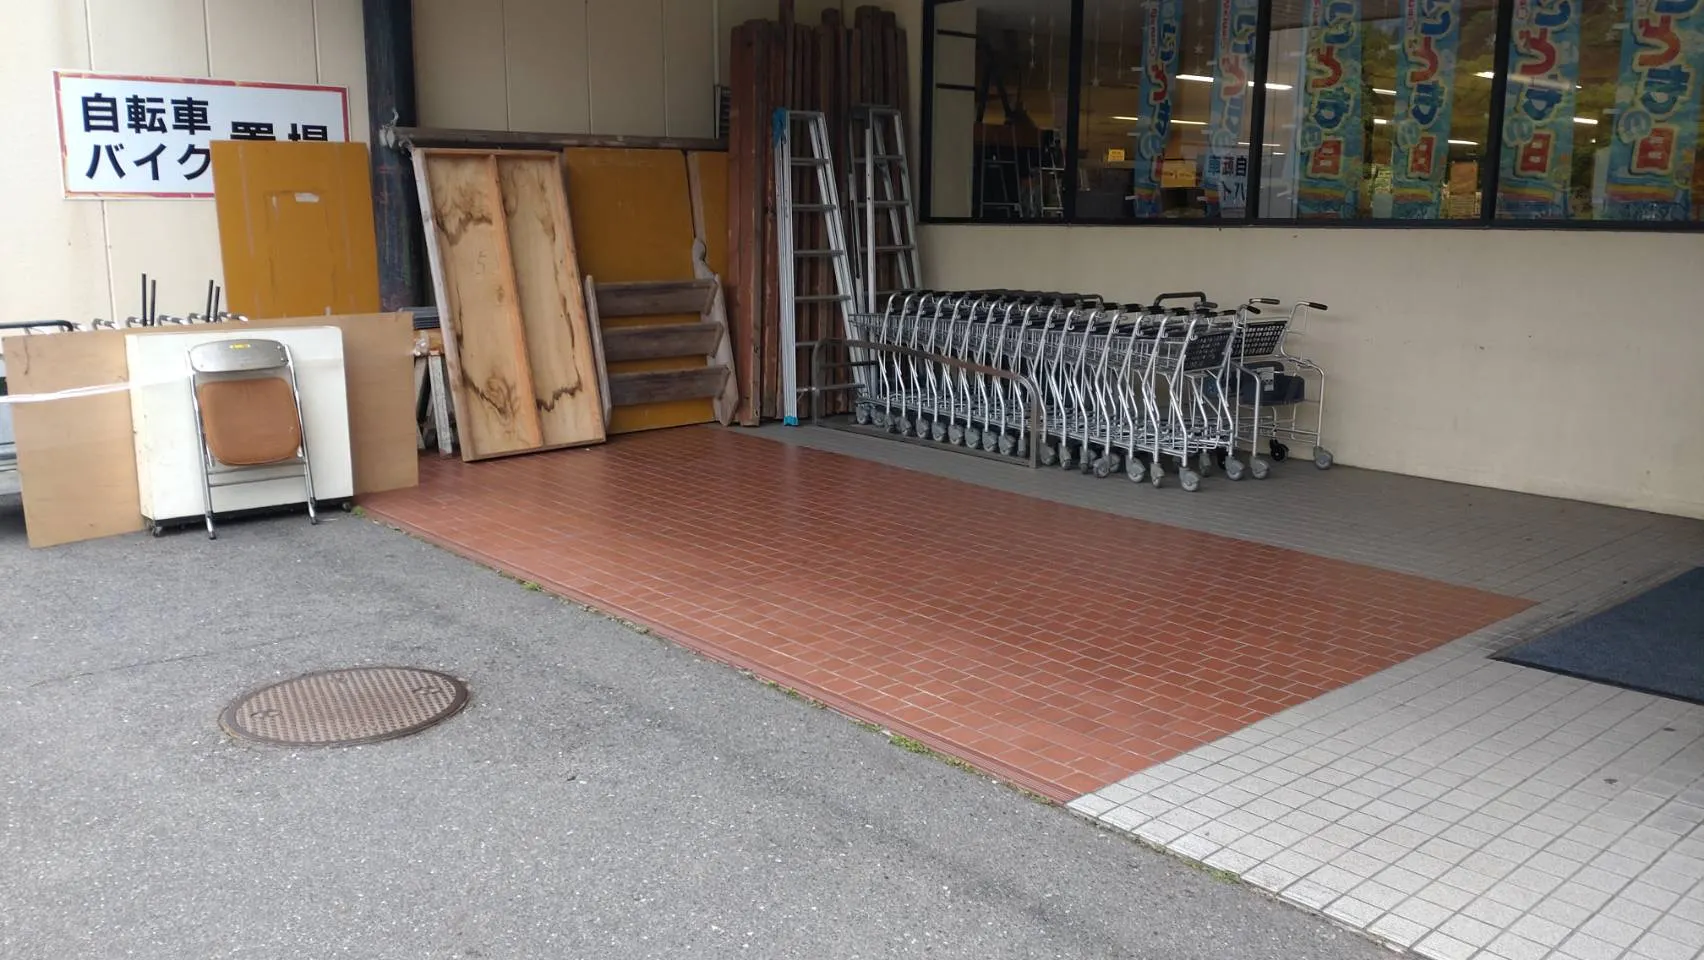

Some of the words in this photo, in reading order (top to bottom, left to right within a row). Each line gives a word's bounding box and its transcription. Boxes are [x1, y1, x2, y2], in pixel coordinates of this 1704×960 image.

[82, 92, 211, 135] 自転車
[85, 143, 212, 181] バイク
